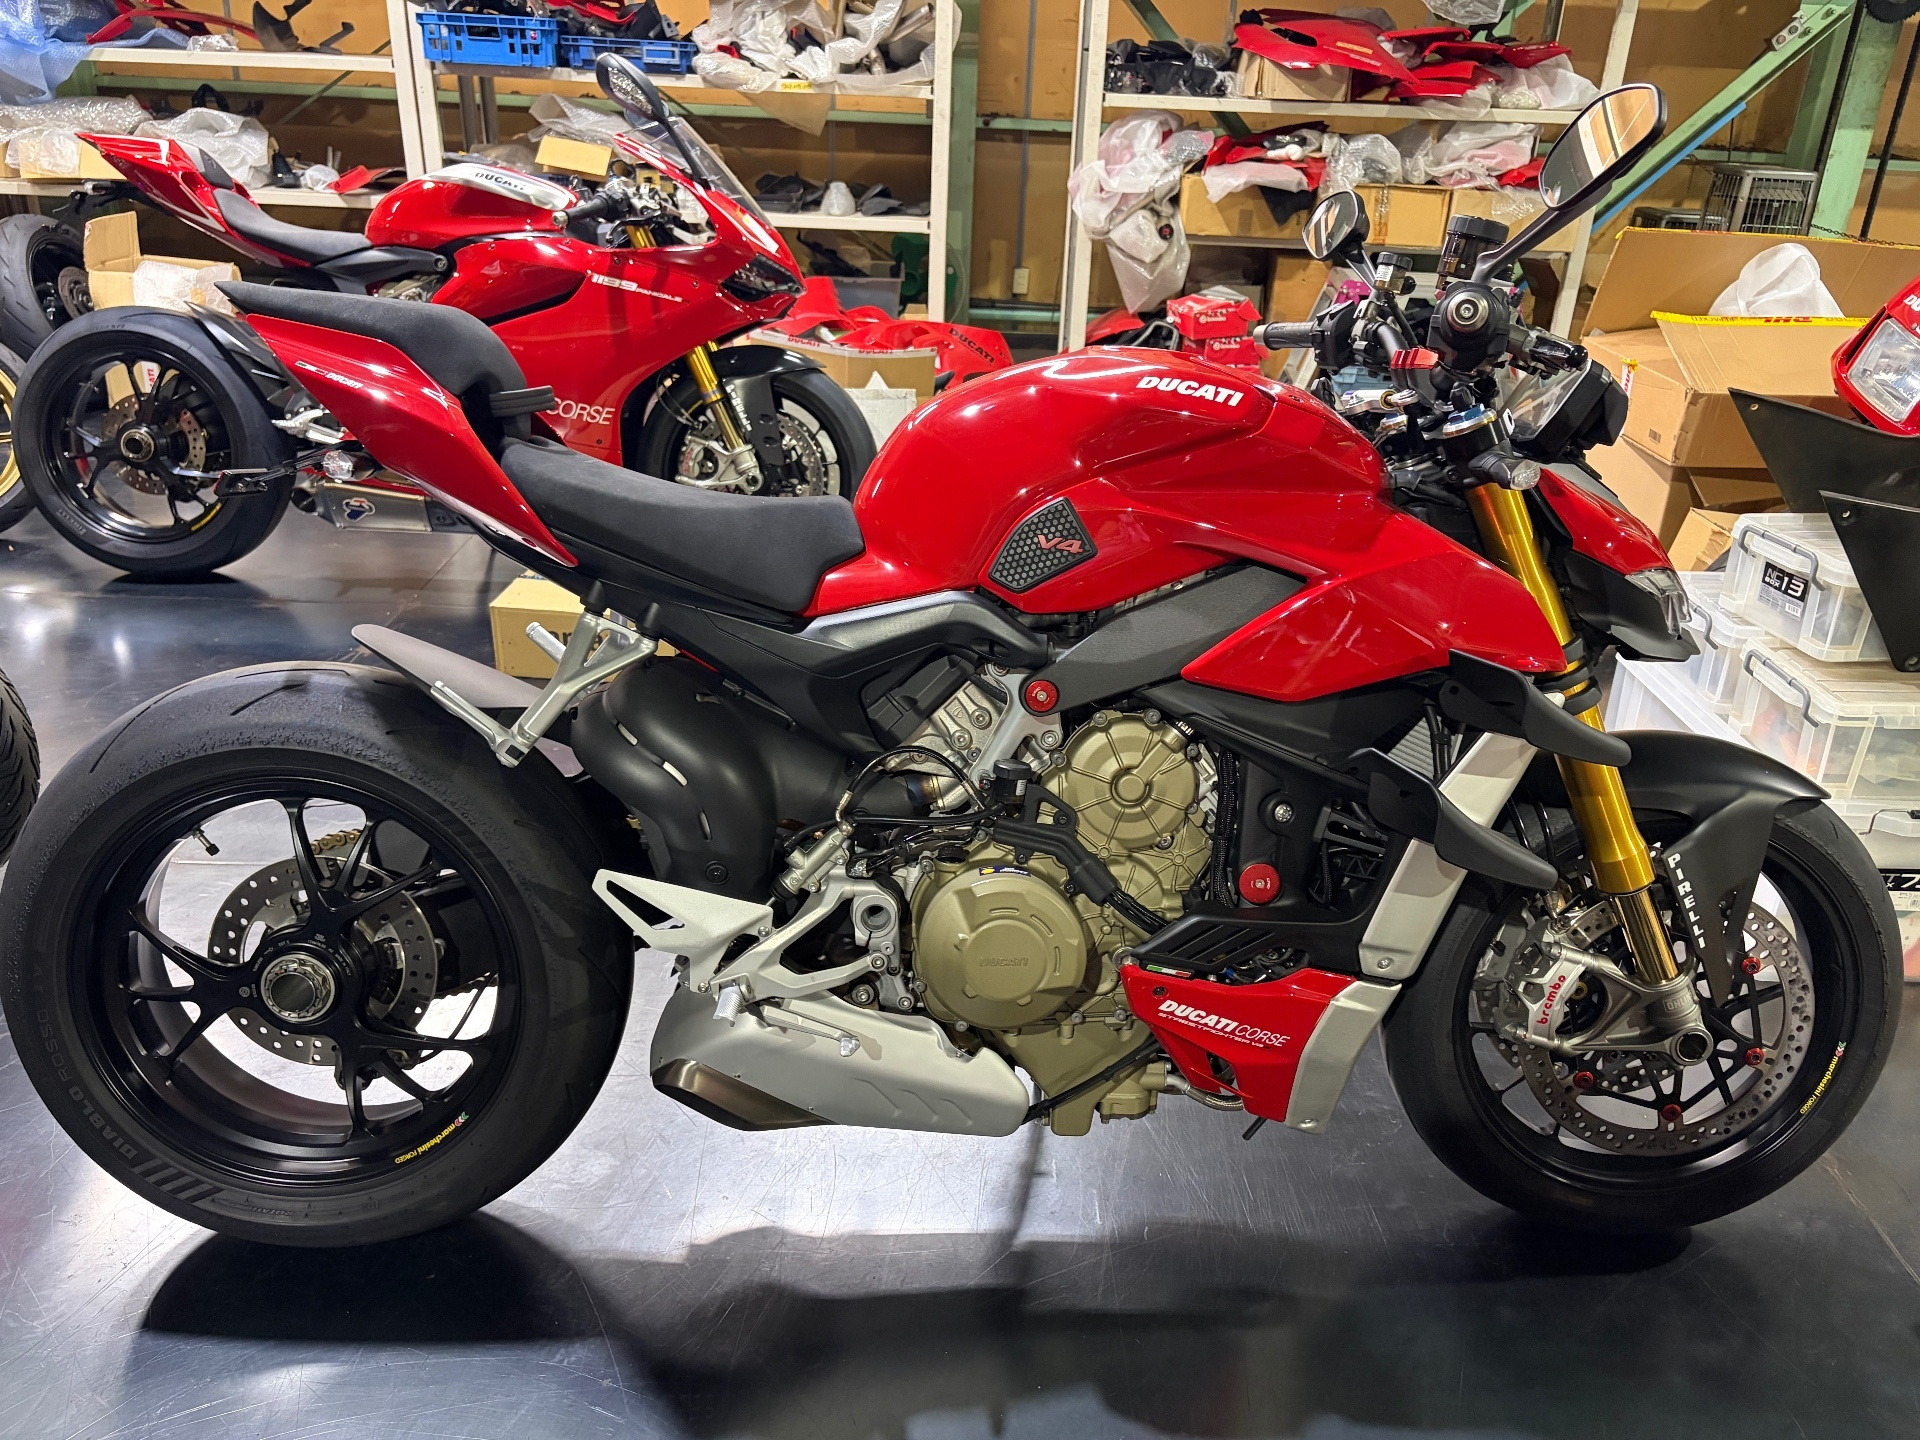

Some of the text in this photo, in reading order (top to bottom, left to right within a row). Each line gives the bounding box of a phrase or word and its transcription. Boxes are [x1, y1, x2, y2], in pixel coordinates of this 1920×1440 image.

[949, 328, 995, 363] DUCATI
[325, 371, 364, 389] DUCATI
[1136, 376, 1245, 407] DUCATI
[725, 384, 753, 432] PIRELLI
[1037, 534, 1083, 554] V4
[1781, 576, 1805, 597] 13
[1667, 852, 1706, 949] PIRELLI
[979, 957, 1029, 967] DUCATI
[1536, 974, 1567, 1025] brembo
[36, 1008, 71, 1083] ROSSO
[1158, 1000, 1291, 1047] DUCATI CORSE
[1799, 1055, 1839, 1115] marchesini FORGED
[68, 1085, 138, 1161] DIABLO
[394, 1123, 456, 1164] marchesini FORGED
